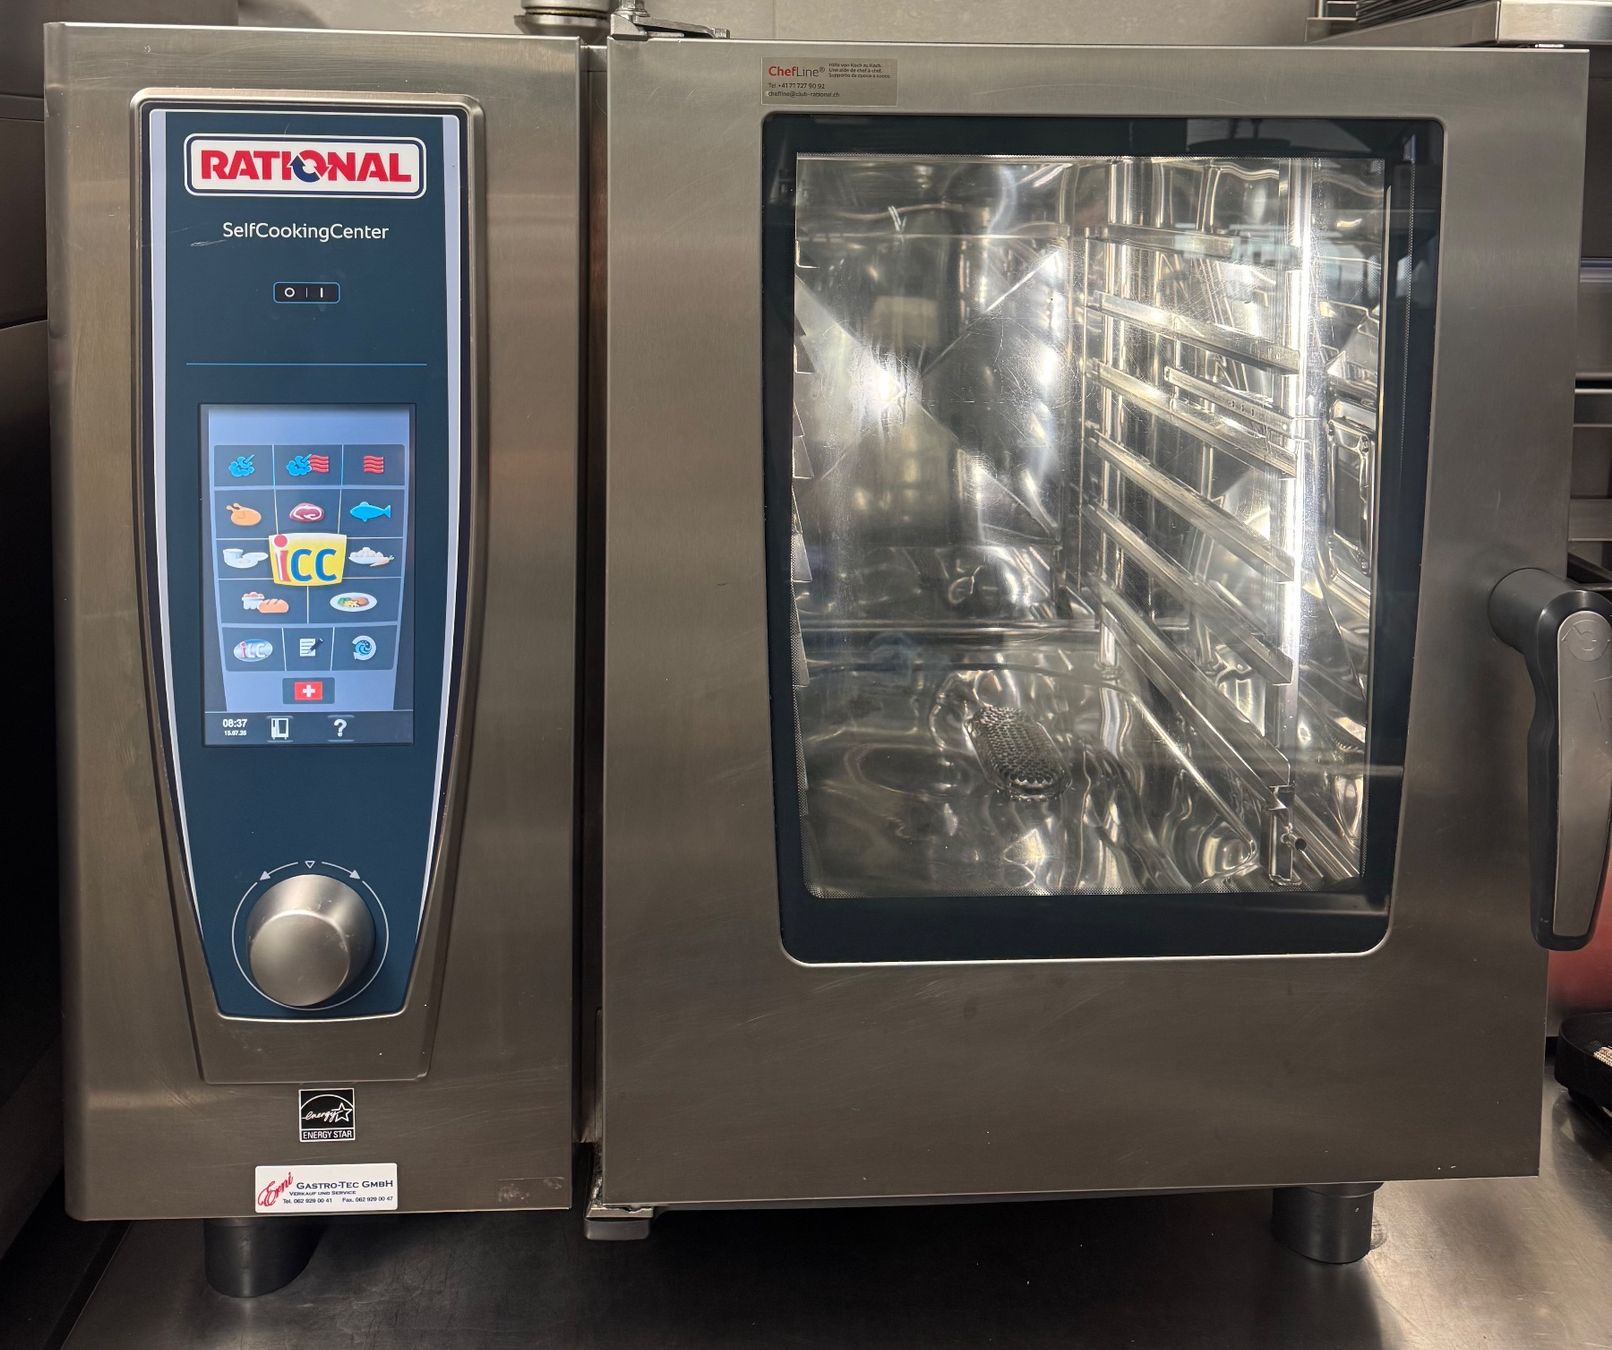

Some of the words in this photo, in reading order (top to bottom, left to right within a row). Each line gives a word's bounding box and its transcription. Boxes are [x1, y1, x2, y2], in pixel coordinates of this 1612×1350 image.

[201, 150, 412, 182] RATIONAL
[223, 222, 389, 242] SelfCookingCenter
[223, 719, 247, 727] 08:37
[303, 1131, 332, 1139] ENERGY
[333, 1130, 352, 1138] STAR
